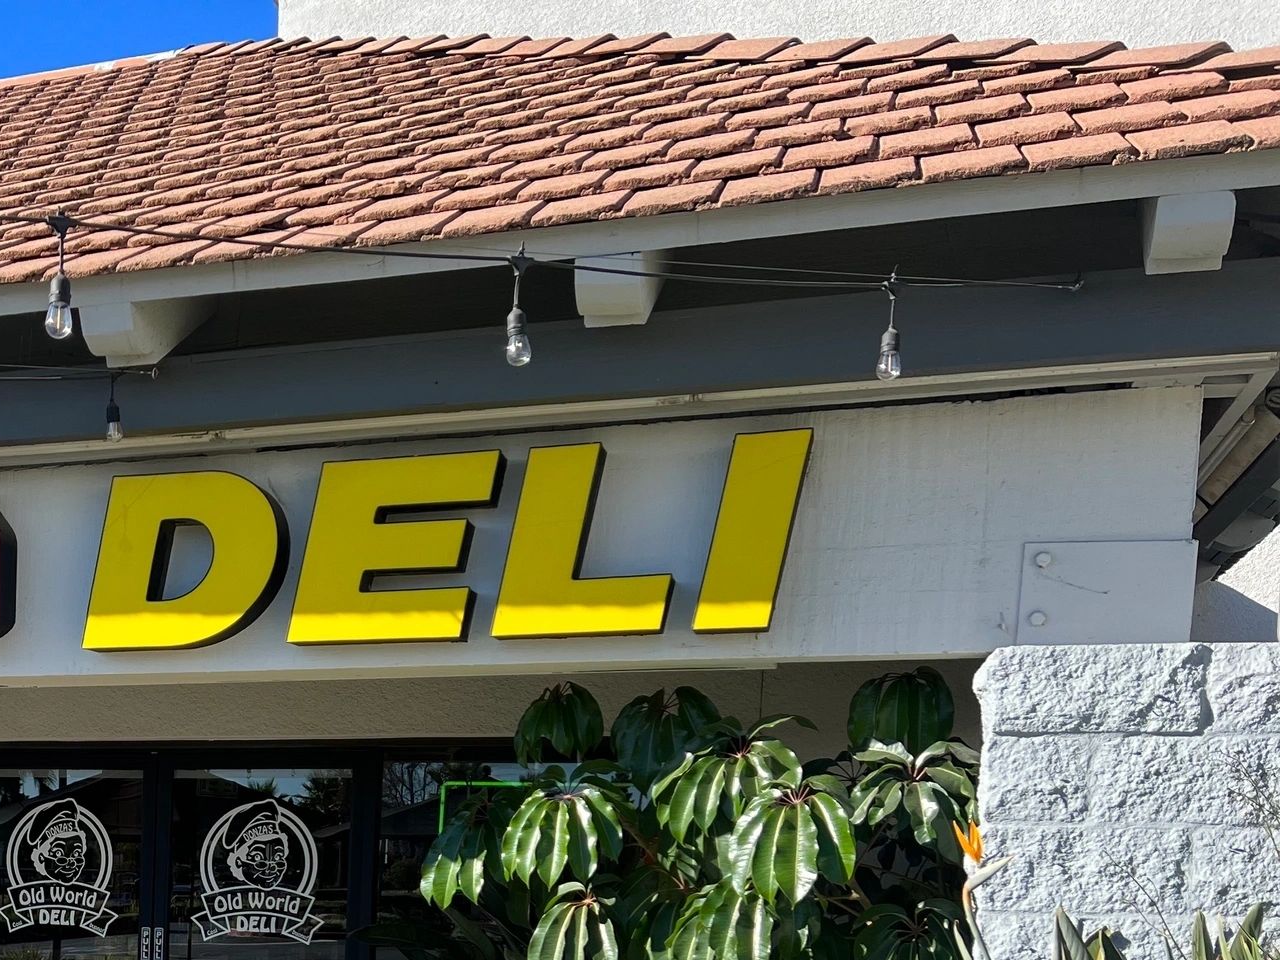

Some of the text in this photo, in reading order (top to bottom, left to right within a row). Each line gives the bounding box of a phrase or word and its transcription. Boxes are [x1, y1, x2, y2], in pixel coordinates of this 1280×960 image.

[82, 427, 813, 652] DELI
[19, 886, 97, 908] Old World
[214, 891, 300, 914] Old World
[38, 908, 75, 926] DELI
[236, 915, 276, 933] DELI
